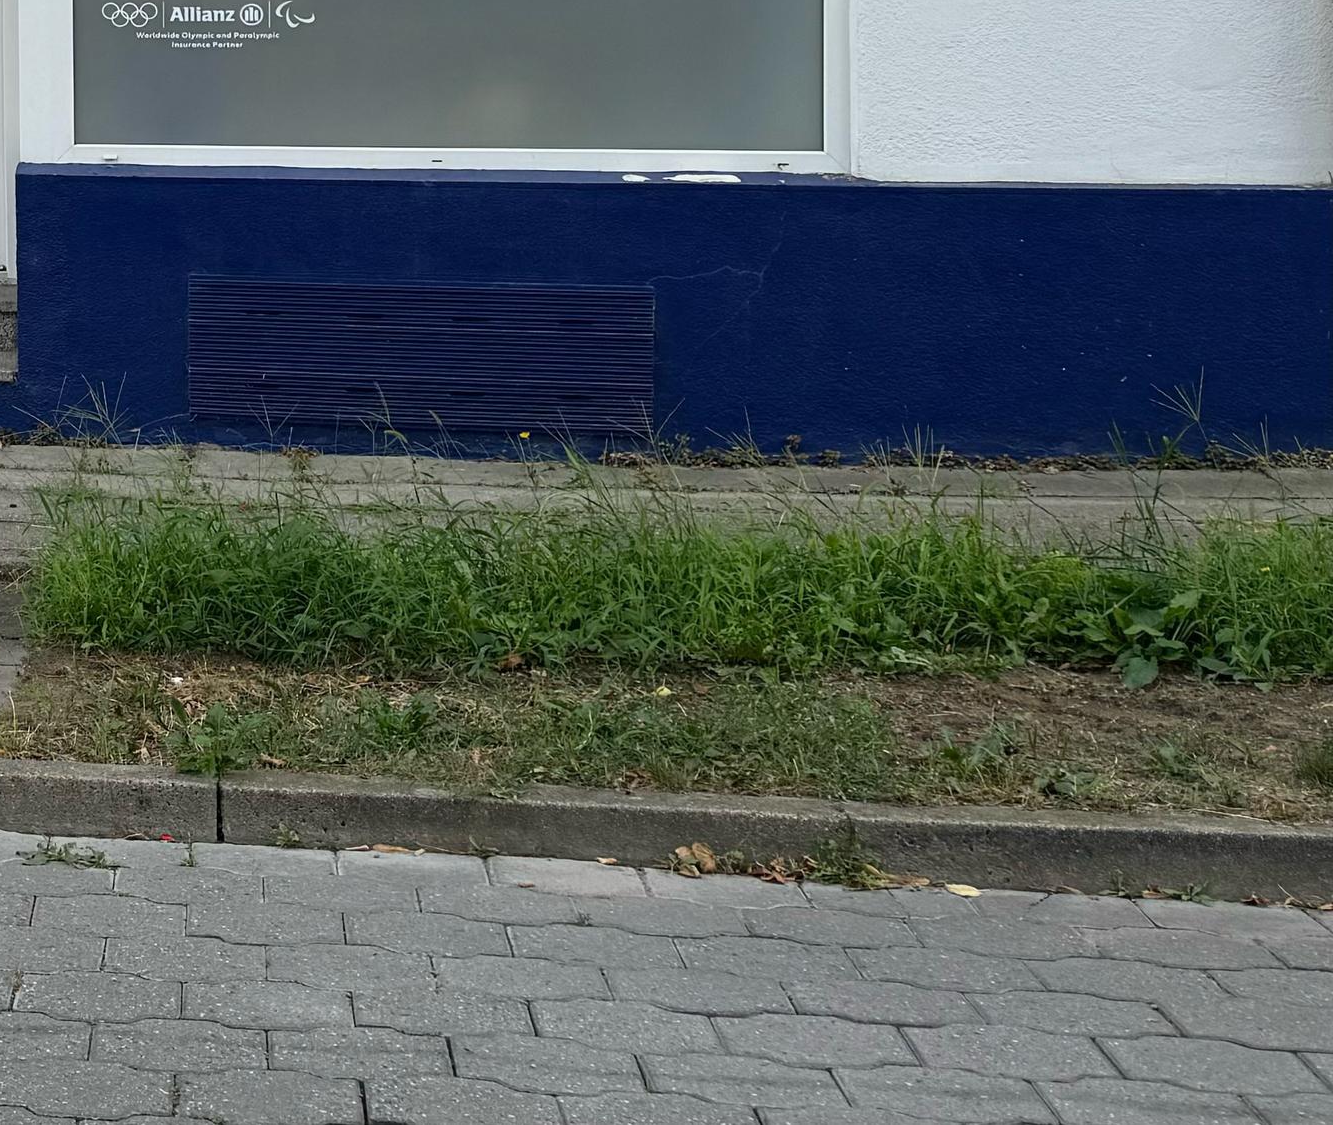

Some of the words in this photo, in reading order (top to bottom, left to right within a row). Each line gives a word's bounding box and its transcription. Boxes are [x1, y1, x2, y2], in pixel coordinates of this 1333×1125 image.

[169, 6, 235, 22] Allianz
[136, 31, 180, 39] Worldwide
[181, 31, 214, 40] Olympic
[216, 31, 232, 39] and
[234, 31, 280, 40] Paralympic
